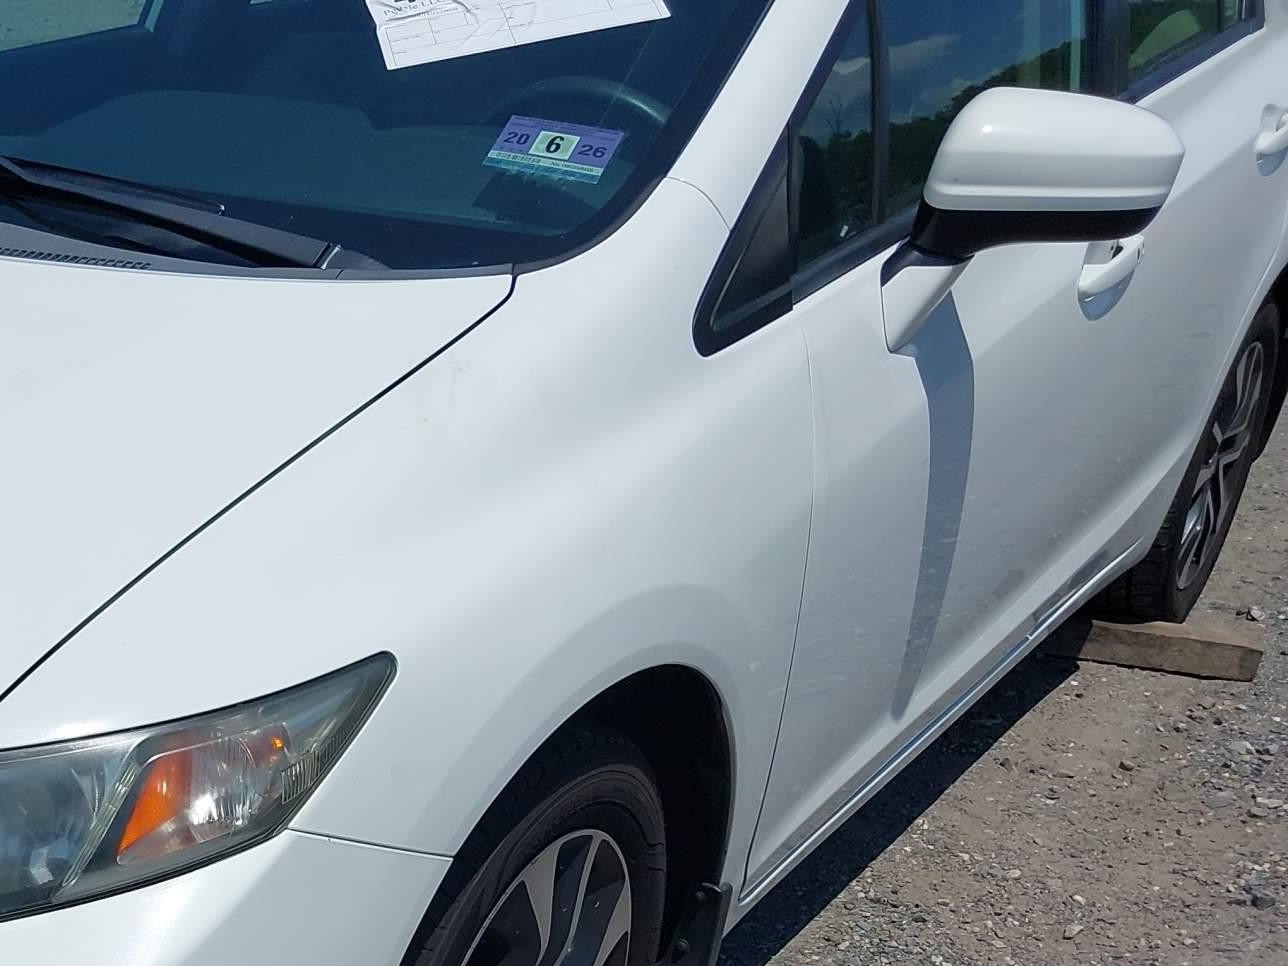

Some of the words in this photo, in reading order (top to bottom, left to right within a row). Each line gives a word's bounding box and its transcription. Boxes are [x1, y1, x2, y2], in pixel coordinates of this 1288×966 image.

[503, 131, 530, 146] 20
[545, 135, 565, 154] 6
[578, 144, 608, 159] 26
